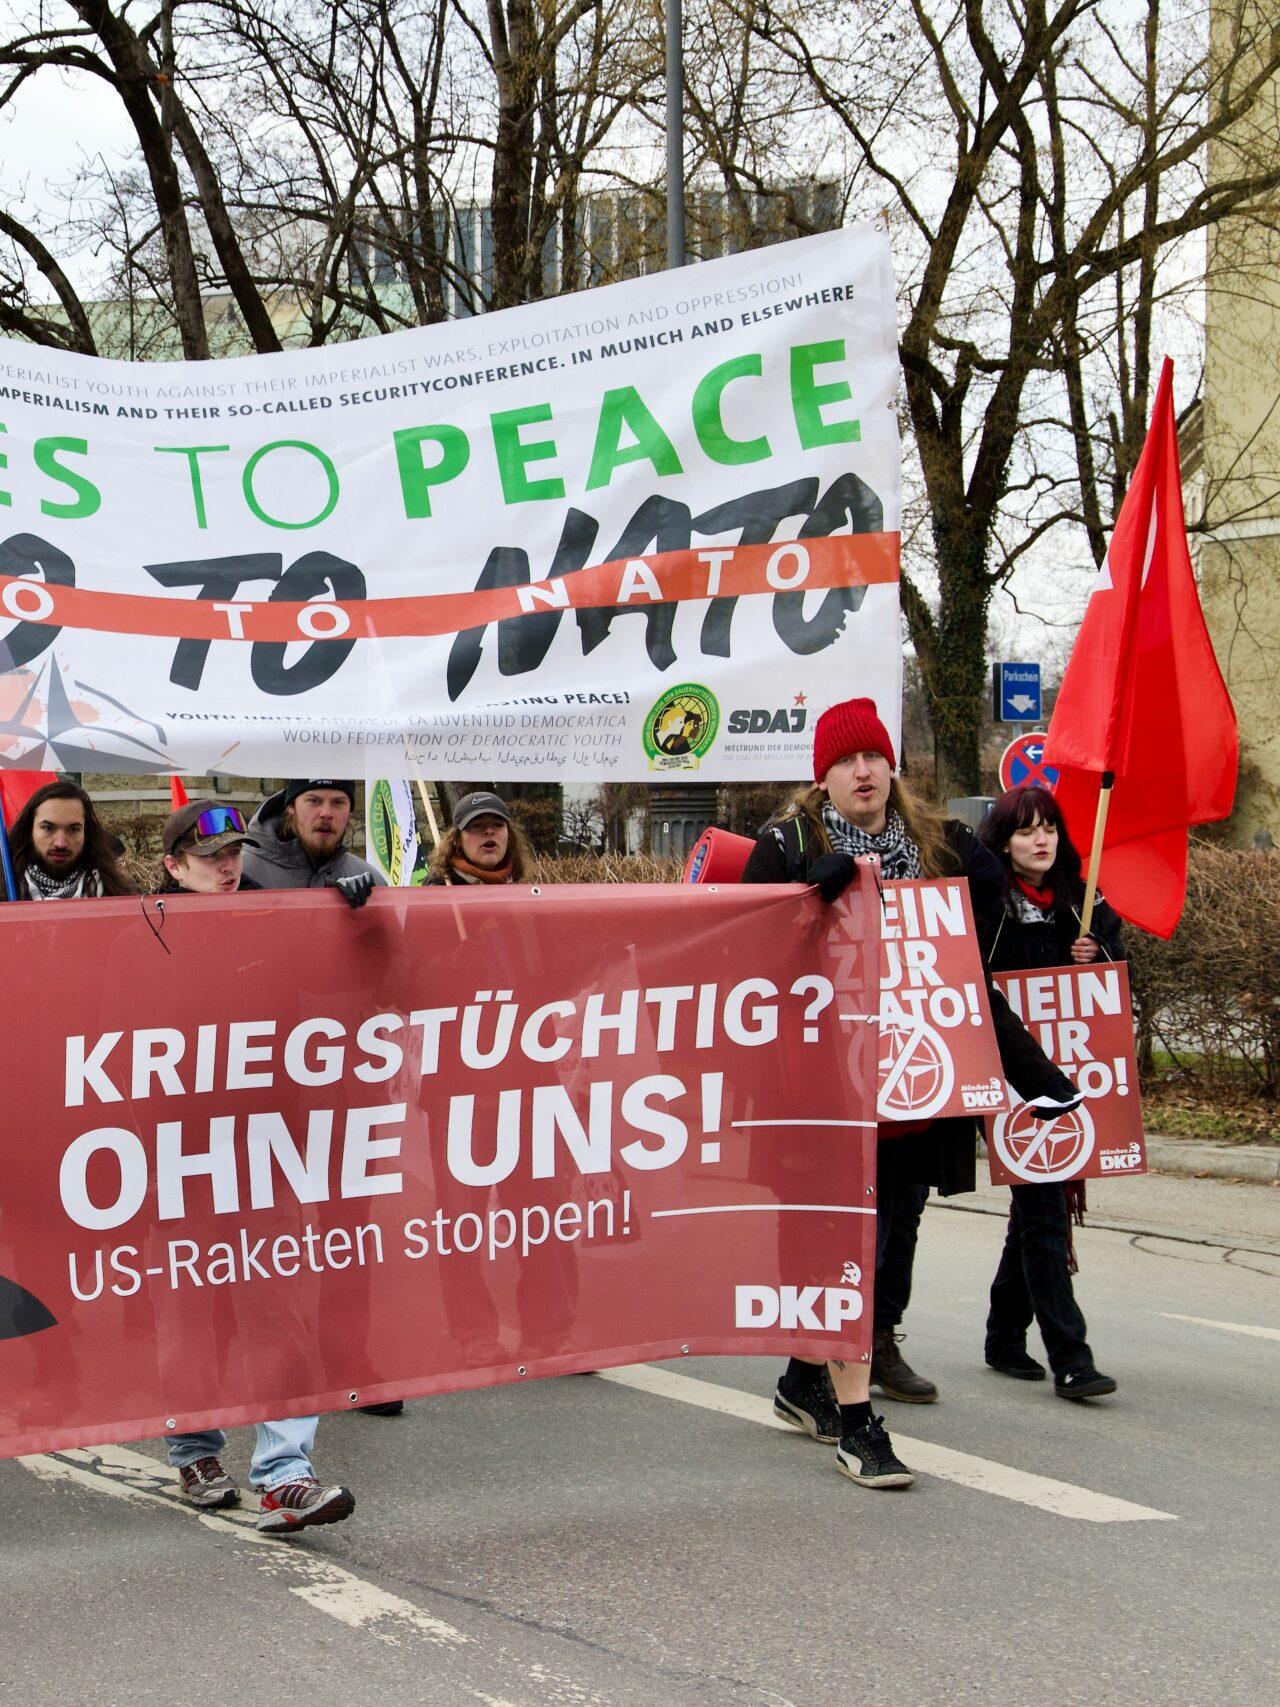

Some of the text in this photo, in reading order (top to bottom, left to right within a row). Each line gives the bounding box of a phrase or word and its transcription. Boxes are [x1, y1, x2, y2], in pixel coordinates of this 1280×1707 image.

[86, 380, 149, 398] YOUTH
[156, 384, 237, 399] AGAINST
[243, 377, 297, 393] THEIR
[304, 358, 417, 388] IMPERIALIST
[423, 347, 483, 370] WARS,
[488, 317, 620, 357] EXPLOITATION
[627, 305, 669, 328] AND
[117, 406, 158, 419] AND
[164, 407, 221, 419] THEIR
[228, 397, 333, 417] SO-CALLED
[339, 356, 566, 408] SECURITYCONFERENCE.
[571, 348, 594, 366] IN
[600, 328, 684, 359] MUNICH
[691, 316, 734, 340] AND
[741, 284, 855, 326] ELSEWHERE
[153, 440, 340, 531] TO
[393, 338, 863, 521] PEACE
[143, 550, 367, 696] TO
[446, 472, 884, 703] NATO
[1003, 670, 1039, 683] Parkschein
[565, 692, 631, 705] PEACE!
[283, 729, 622, 747] WORLD FEDERATION OF DEMOCRATIC YOUTH
[433, 714, 516, 728] JUVENTUD
[521, 713, 626, 728] DEMOCRÁTICA
[728, 708, 807, 734] SDAJ
[724, 744, 765, 752] WELTBUND
[767, 743, 782, 751] DER
[64, 974, 835, 1108] KRIEGSTÜCHTIG?
[961, 1090, 1004, 1107] DKP
[58, 1071, 725, 1232] OHNE UNS!
[1100, 1153, 1142, 1170] DKP
[67, 1190, 632, 1301] US-Raketen stoppen!
[734, 1284, 863, 1332] DKP
